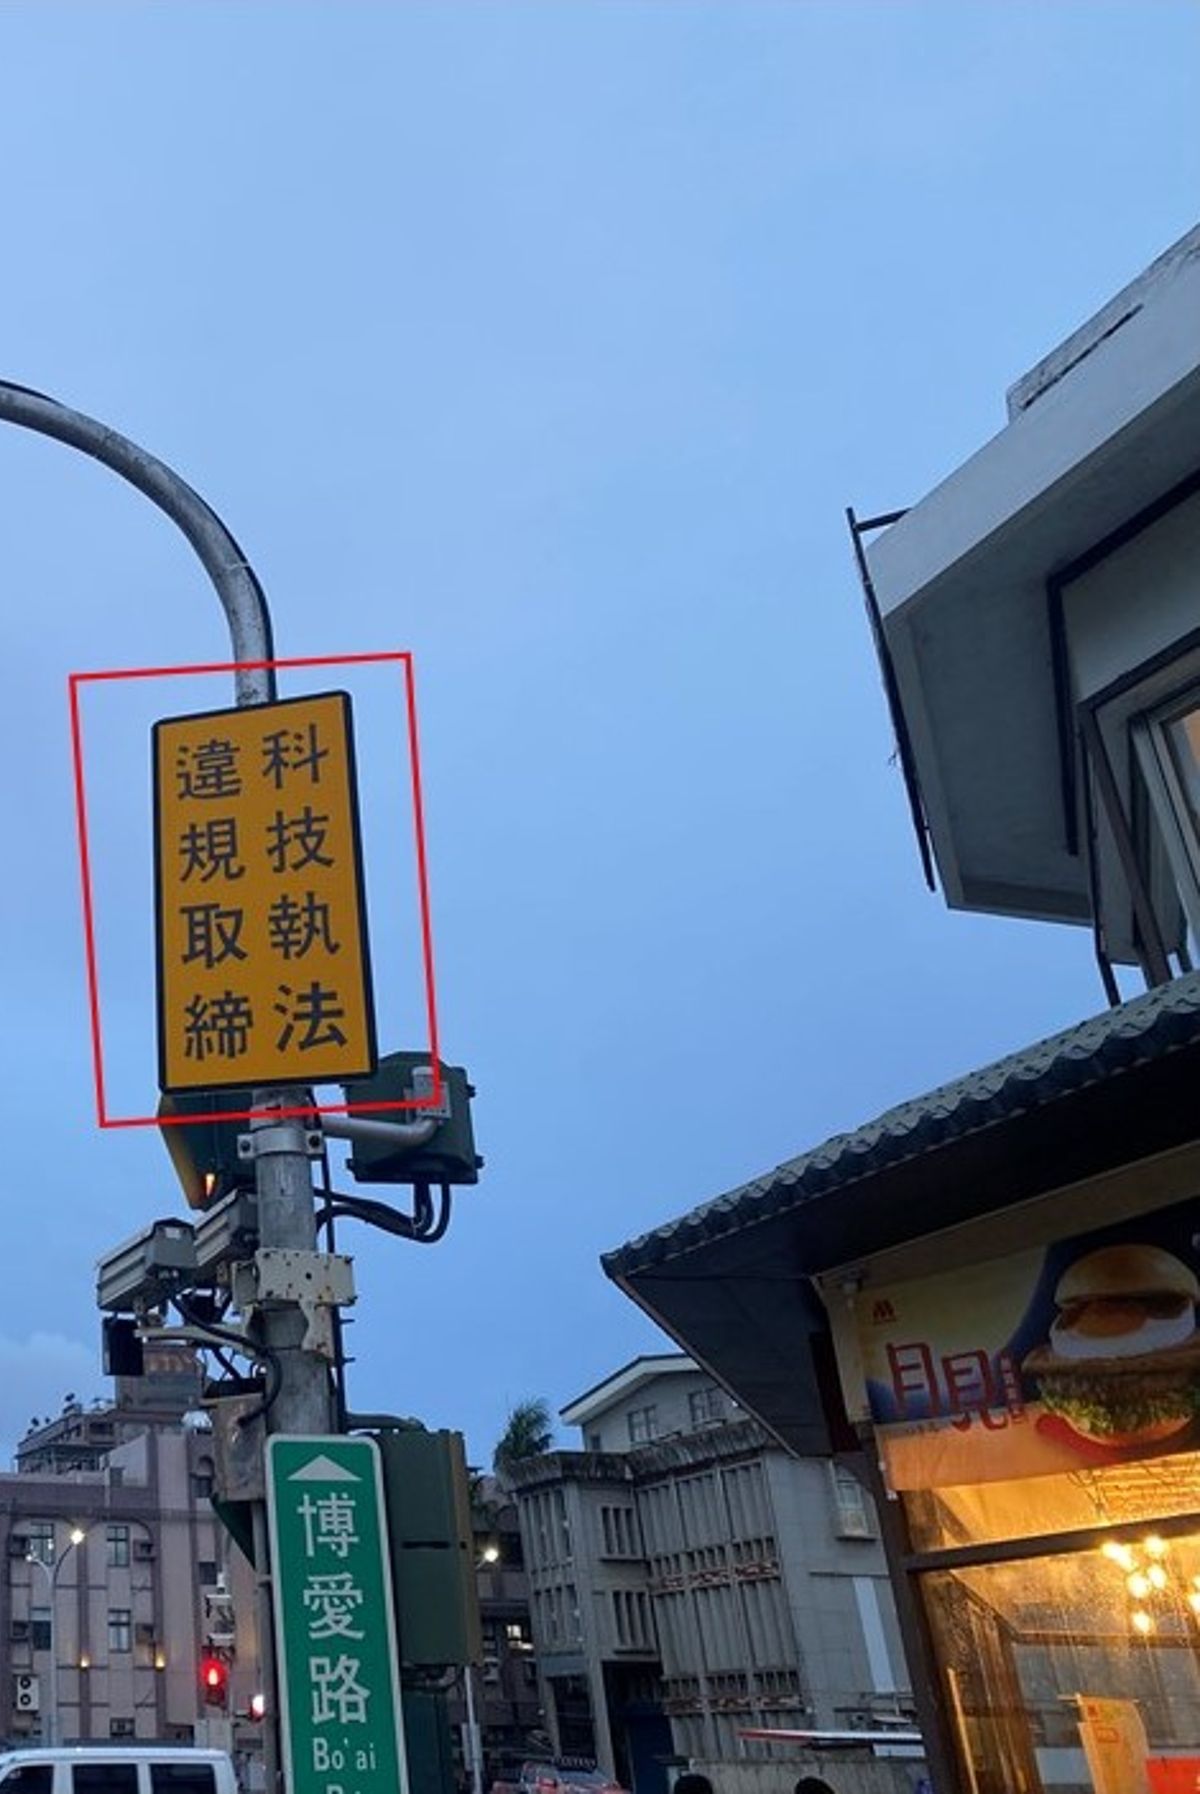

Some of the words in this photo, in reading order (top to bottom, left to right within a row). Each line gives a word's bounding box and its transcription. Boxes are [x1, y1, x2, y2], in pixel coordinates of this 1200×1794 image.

[176, 738, 254, 1061] 違規取締
[262, 724, 348, 1052] 科技執法
[297, 1492, 371, 1725] 博愛路
[312, 1736, 377, 1772] Bo'ai
